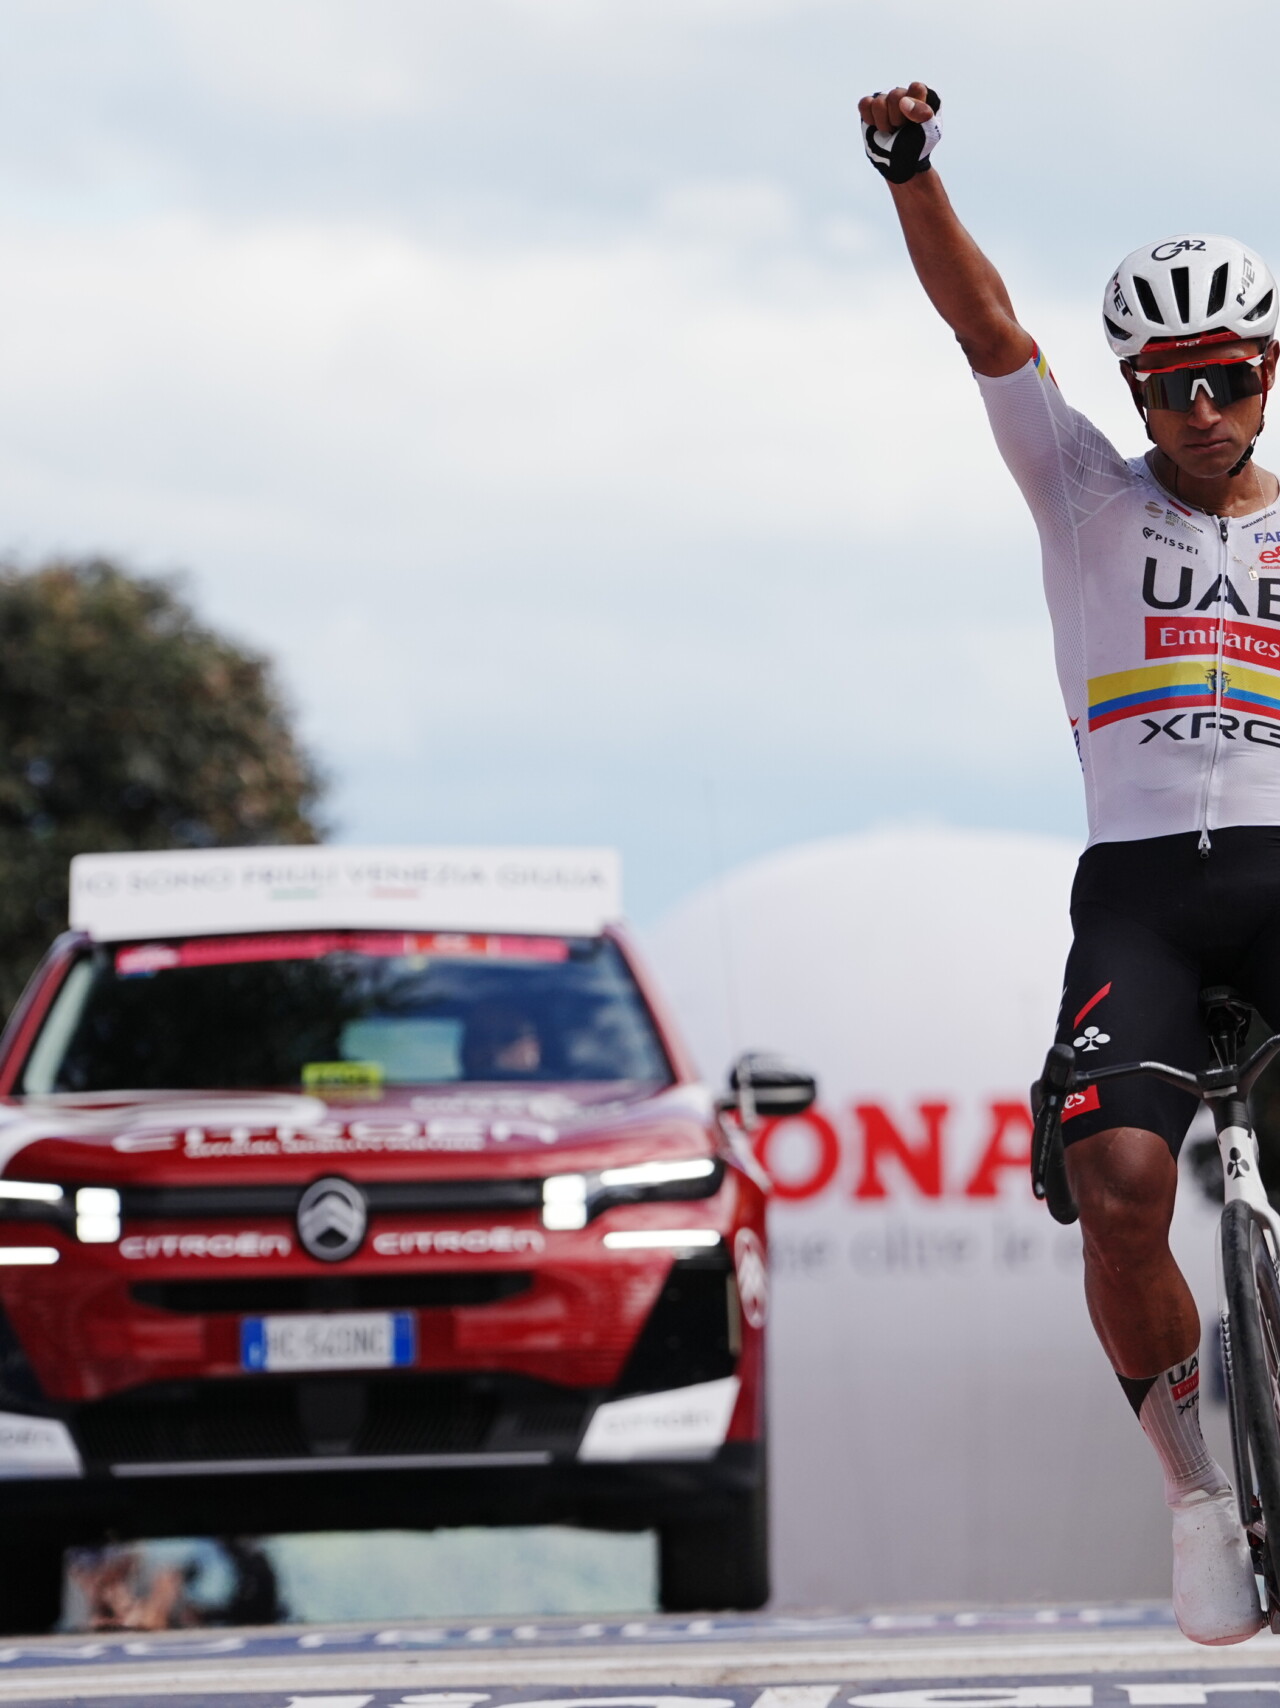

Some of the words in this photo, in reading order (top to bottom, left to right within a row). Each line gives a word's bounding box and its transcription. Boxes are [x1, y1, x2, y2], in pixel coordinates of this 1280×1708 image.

[1151, 239, 1206, 261] G42
[1113, 272, 1133, 317] MET
[1236, 254, 1256, 307] MET
[1155, 534, 1199, 555] PISSEI
[1159, 626, 1280, 659] Emirates
